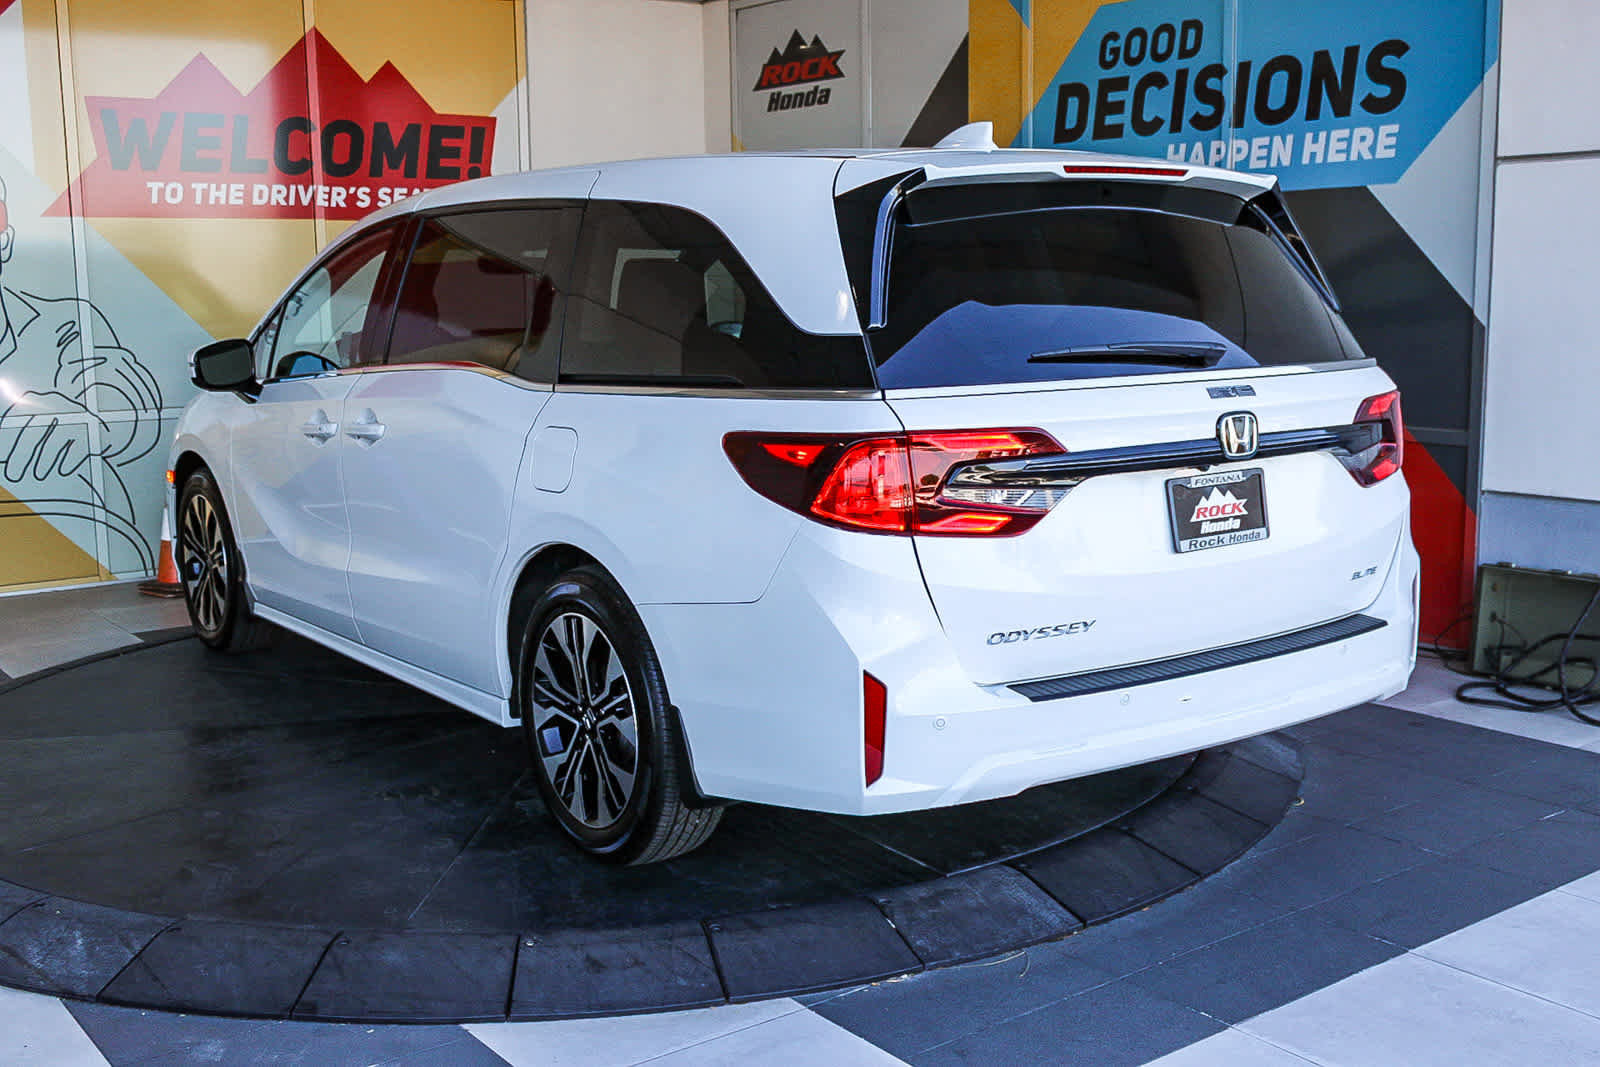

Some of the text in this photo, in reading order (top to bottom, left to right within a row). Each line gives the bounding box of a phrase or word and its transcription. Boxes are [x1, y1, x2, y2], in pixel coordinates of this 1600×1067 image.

[1099, 19, 1203, 70] GOOD
[762, 54, 840, 87] ROCK
[767, 85, 831, 112] Honda
[1053, 39, 1410, 144] DECISIONS
[100, 108, 486, 180] WELCOME!
[1302, 124, 1400, 165] HERE
[146, 182, 184, 204] TO
[192, 183, 244, 205] THE
[252, 184, 371, 209] DRIVER'S
[1194, 473, 1242, 486] FONTANA
[1196, 502, 1243, 519] ROCK
[1201, 518, 1240, 534] Honda
[1189, 531, 1261, 549] Rock Honda
[987, 619, 1096, 645] ODYSSEY
